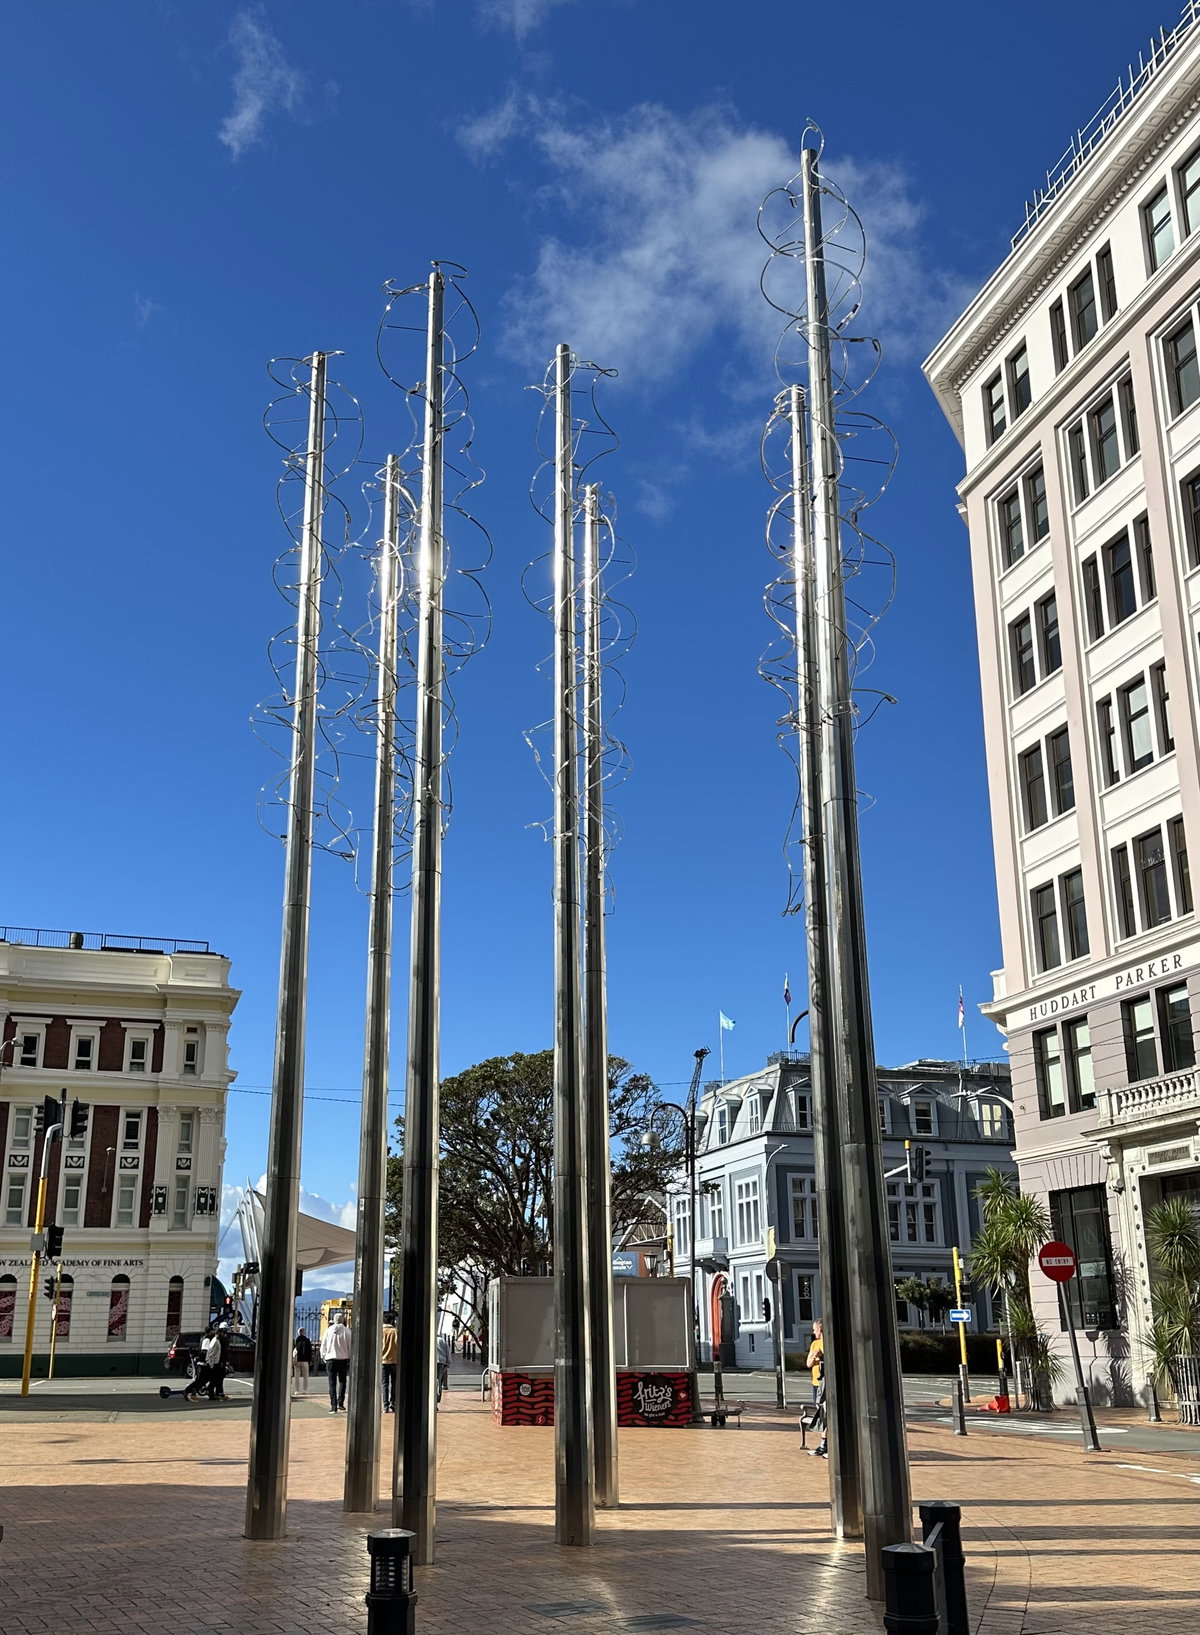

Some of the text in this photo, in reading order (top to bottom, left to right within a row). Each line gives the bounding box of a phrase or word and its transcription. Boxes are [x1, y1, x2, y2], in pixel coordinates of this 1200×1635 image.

[1029, 954, 1183, 1021] HUDDART PARKER
[8, 1259, 49, 1267] ZEALD
[91, 1259, 101, 1267] OF
[103, 1259, 122, 1267] FINE
[123, 1259, 143, 1267] ARTS
